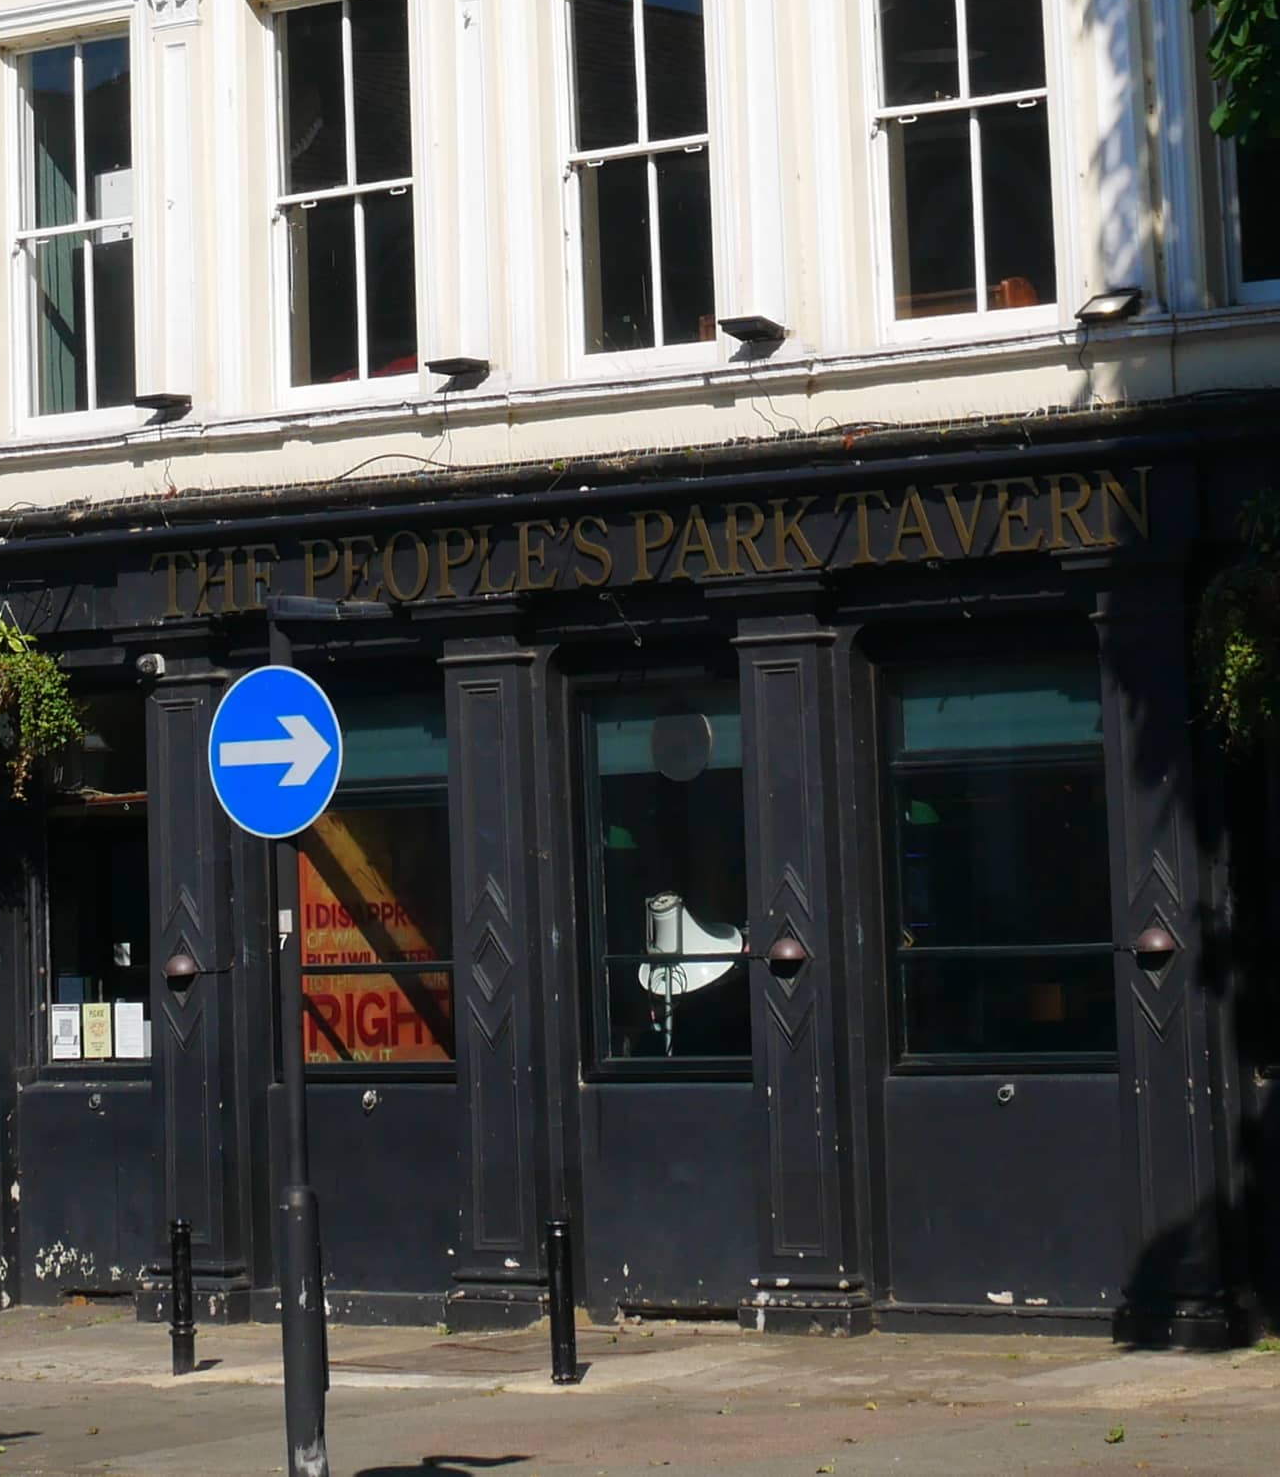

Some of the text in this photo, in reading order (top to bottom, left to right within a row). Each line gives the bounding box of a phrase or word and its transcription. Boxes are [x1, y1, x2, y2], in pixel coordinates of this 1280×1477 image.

[149, 465, 1153, 618] THE PEOPLE'S PARK TAVERN
[278, 933, 288, 951] 7
